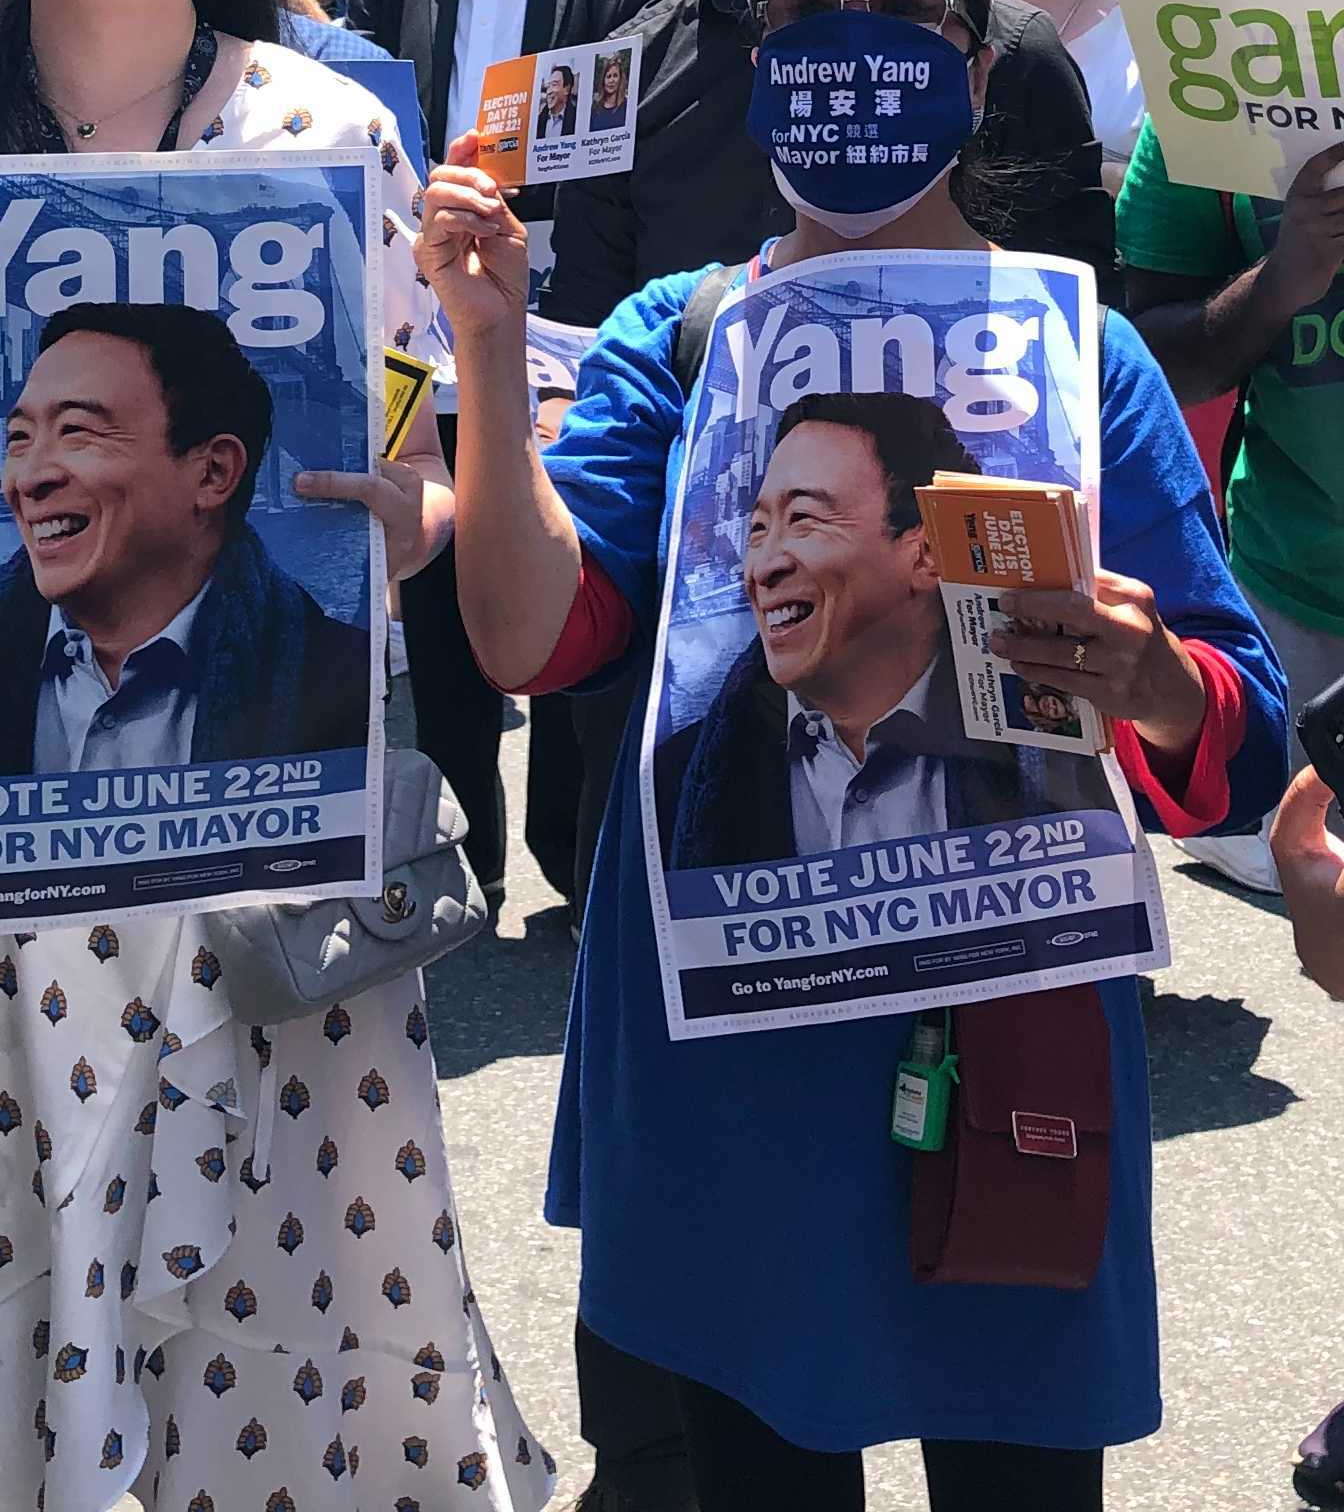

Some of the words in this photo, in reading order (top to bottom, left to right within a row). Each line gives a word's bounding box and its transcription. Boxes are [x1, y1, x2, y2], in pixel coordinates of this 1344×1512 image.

[770, 56, 856, 86] Andrew
[864, 54, 930, 90] Yang
[482, 91, 528, 112] ELECTION
[486, 109, 508, 124] DAY
[508, 106, 519, 119] IS
[1247, 102, 1320, 131] FOR
[775, 146, 840, 169] Mayor
[846, 143, 929, 165] 紐約市長
[726, 302, 1040, 433] Yang
[982, 511, 1002, 551] JUNE
[999, 520, 1014, 551] DAY
[1009, 509, 1035, 583] ELECTION
[990, 551, 1007, 576] 22!
[1005, 551, 1019, 570] IS
[82, 769, 211, 812] JUNE
[224, 759, 322, 800] 22ND
[49, 822, 146, 862] NYC
[157, 804, 321, 851] MAYOR
[713, 859, 838, 908] VOTE
[849, 836, 976, 887] JUNE
[987, 819, 1085, 868] 22ND
[722, 915, 817, 957] FOR
[825, 897, 919, 945] NYC
[928, 869, 1097, 927] MAYOR
[731, 982, 753, 996] Go
[756, 979, 772, 993] to
[772, 963, 889, 992] YangforNY.com
